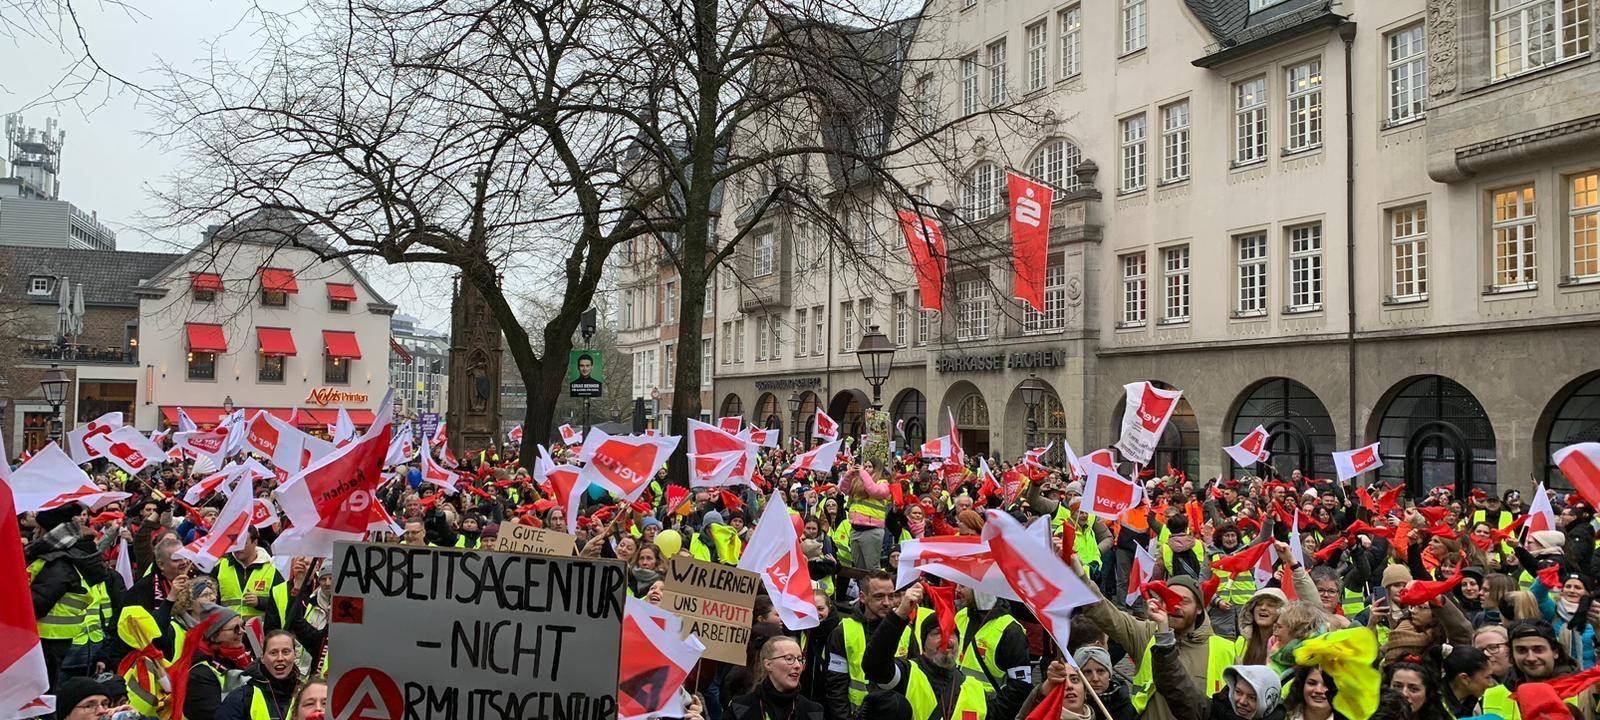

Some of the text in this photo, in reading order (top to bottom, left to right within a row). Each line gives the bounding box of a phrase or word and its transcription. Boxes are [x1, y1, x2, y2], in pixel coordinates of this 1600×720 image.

[935, 350, 1065, 372] SPARKASSE AACHEN
[305, 387, 340, 407] Nobis
[512, 526, 546, 542] GUTE
[335, 545, 624, 623] ARBEITSAGENTUR
[671, 560, 756, 595] WIR LERNEN
[674, 595, 750, 622] UNS KAPUTT
[690, 621, 749, 645] ARBEITEN
[450, 620, 577, 682] NICHT
